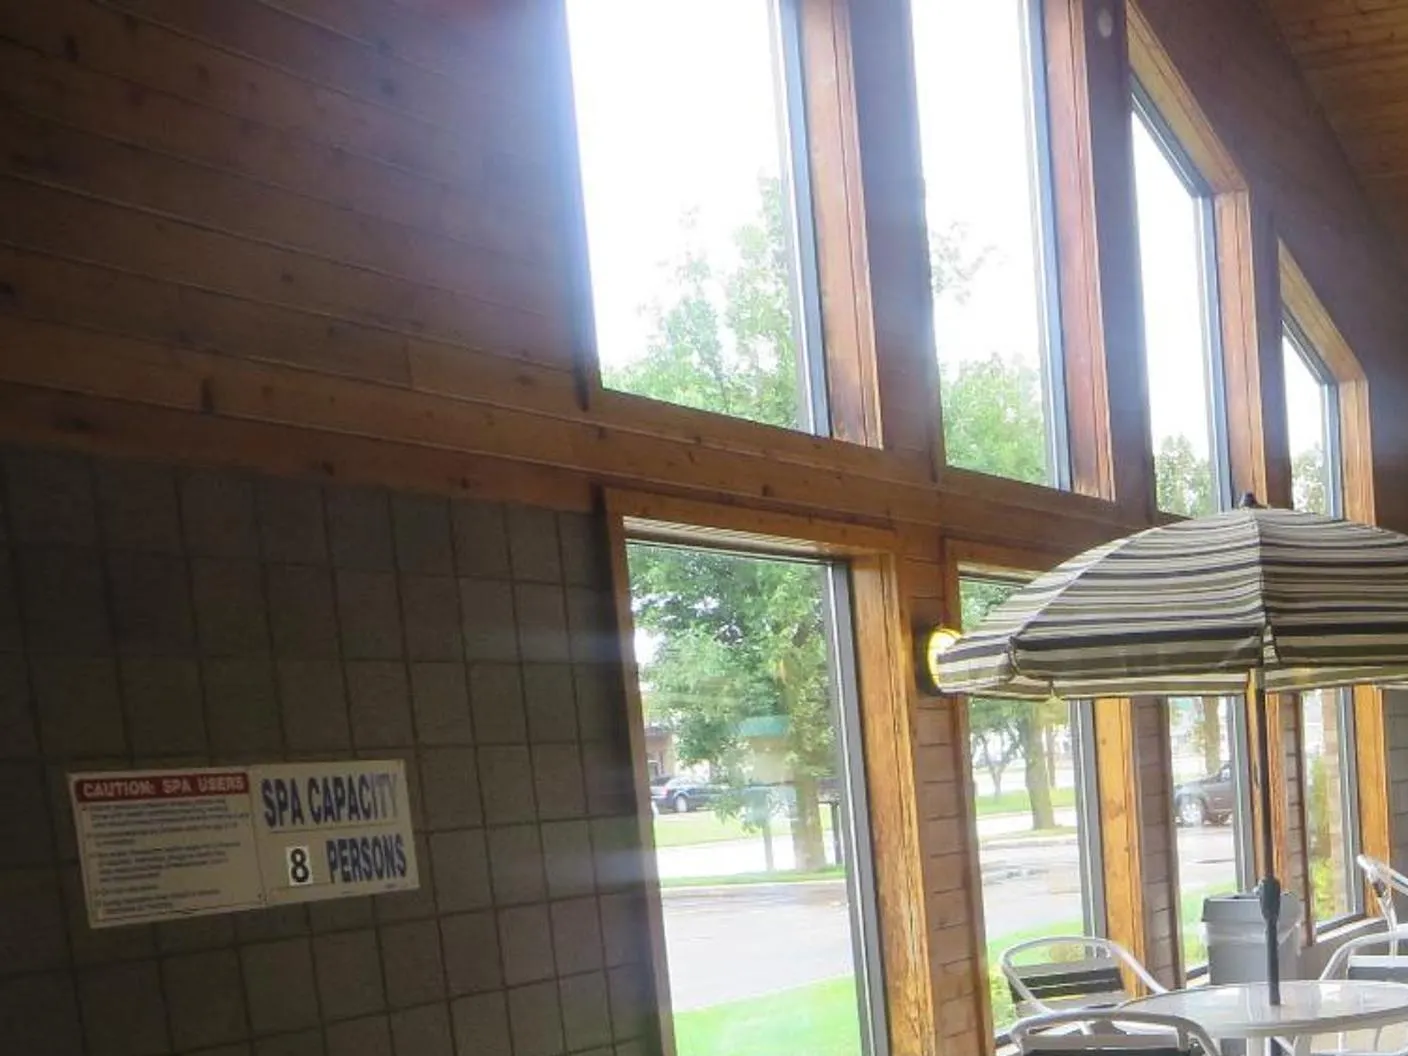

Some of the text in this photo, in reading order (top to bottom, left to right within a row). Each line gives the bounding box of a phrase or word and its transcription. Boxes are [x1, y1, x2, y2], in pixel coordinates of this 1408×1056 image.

[83, 776, 245, 798] CAUTION: SPA USERS
[261, 772, 398, 829] SPA CAPACITY
[289, 834, 408, 885] 8 PERSONS
